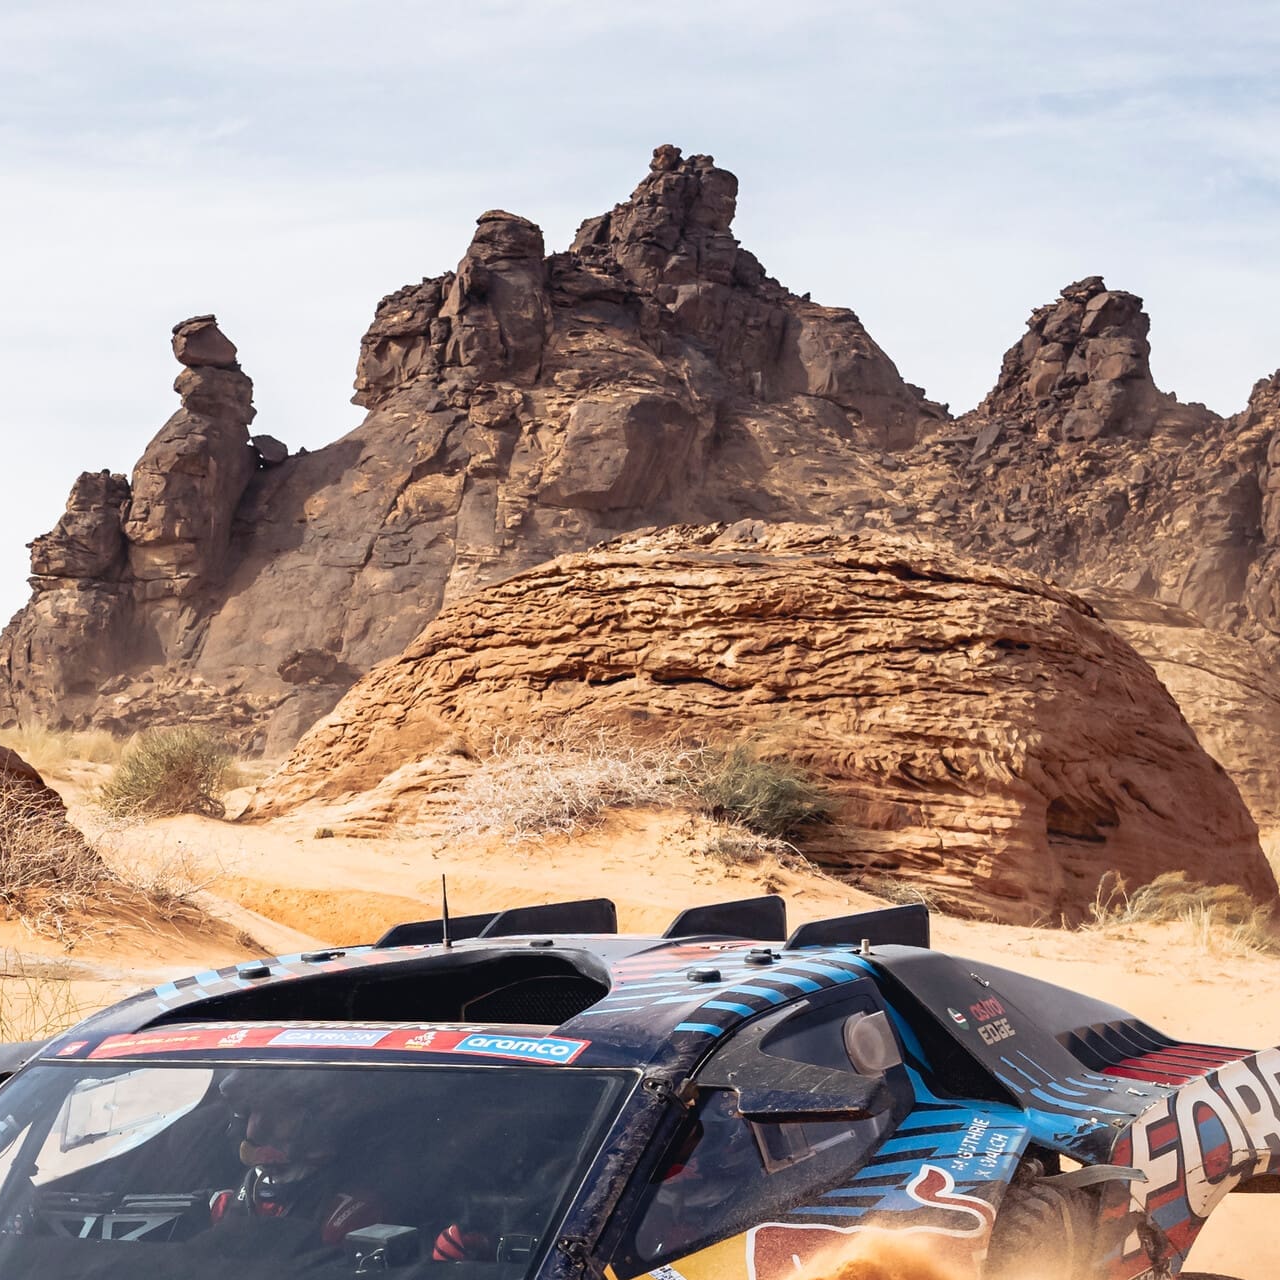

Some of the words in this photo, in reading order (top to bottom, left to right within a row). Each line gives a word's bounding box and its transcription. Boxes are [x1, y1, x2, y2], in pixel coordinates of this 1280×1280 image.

[977, 1018, 1016, 1045] EDGE
[466, 1036, 569, 1056] aramco
[957, 1117, 990, 1159] GUTHRIE
